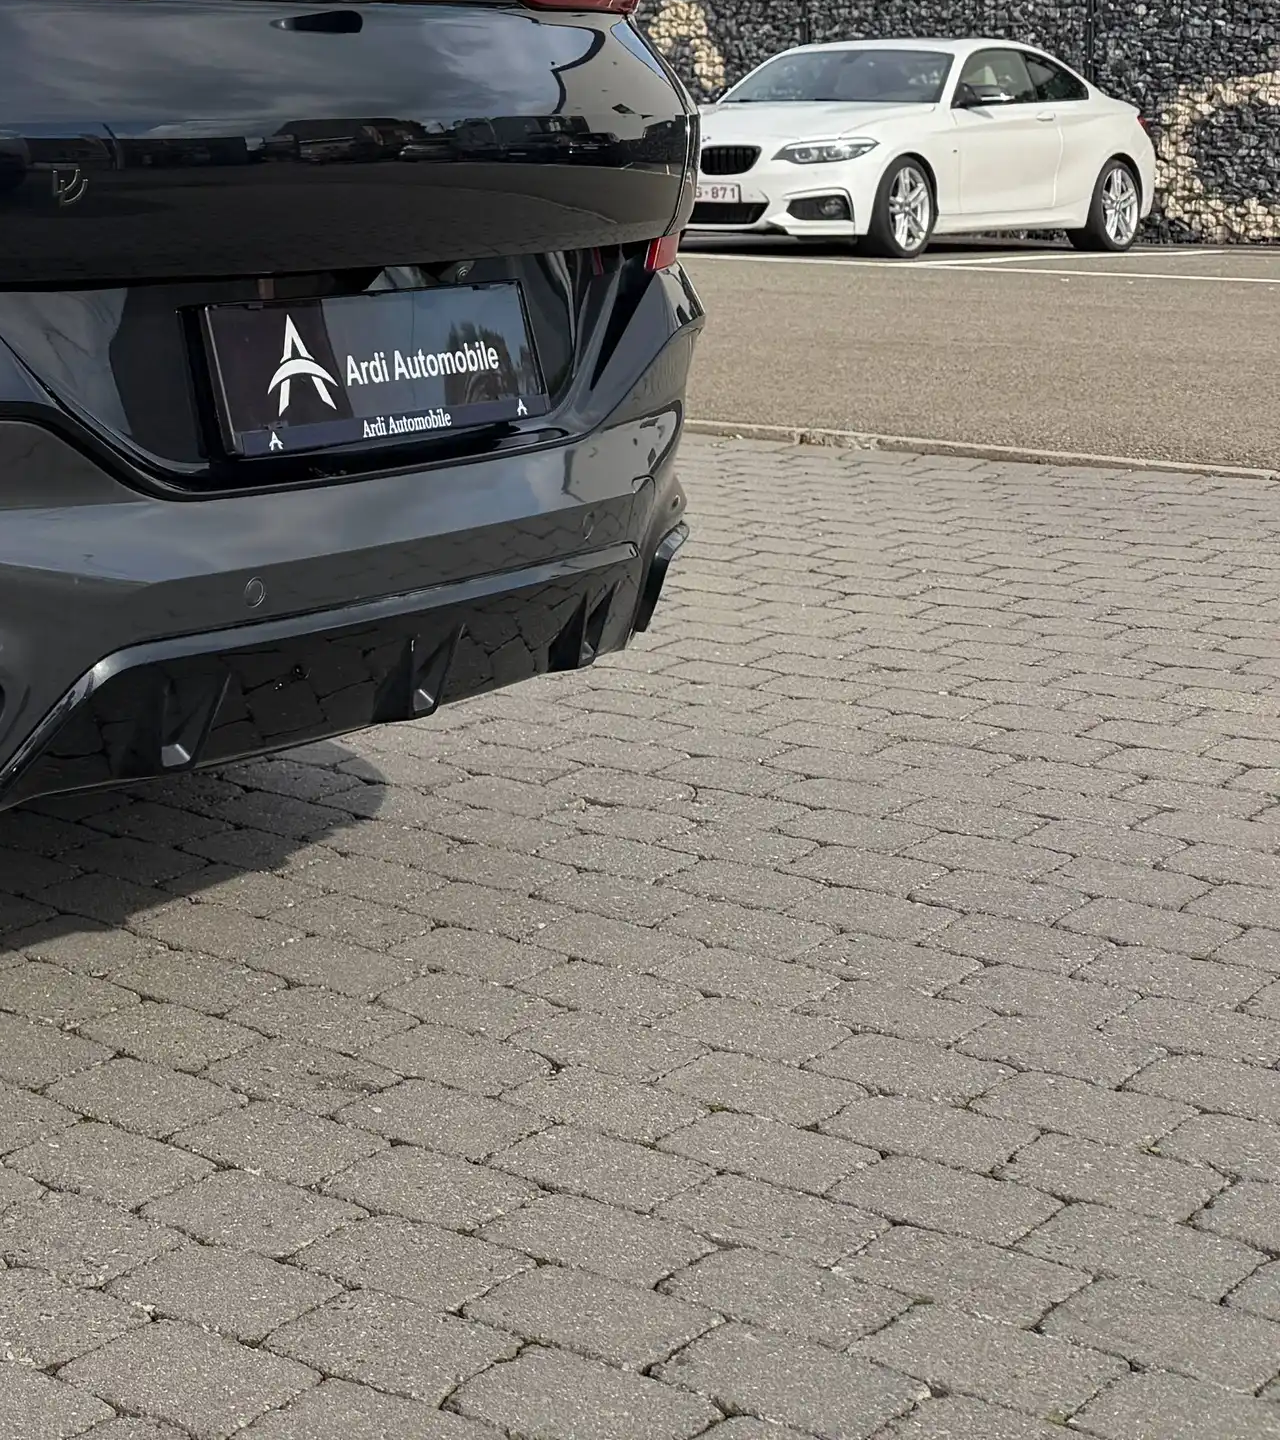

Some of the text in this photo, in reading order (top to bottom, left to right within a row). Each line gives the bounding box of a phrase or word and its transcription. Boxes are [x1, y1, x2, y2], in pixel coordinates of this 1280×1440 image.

[346, 340, 499, 387] Ardi Automobile
[362, 408, 452, 438] Ardi Automobile
